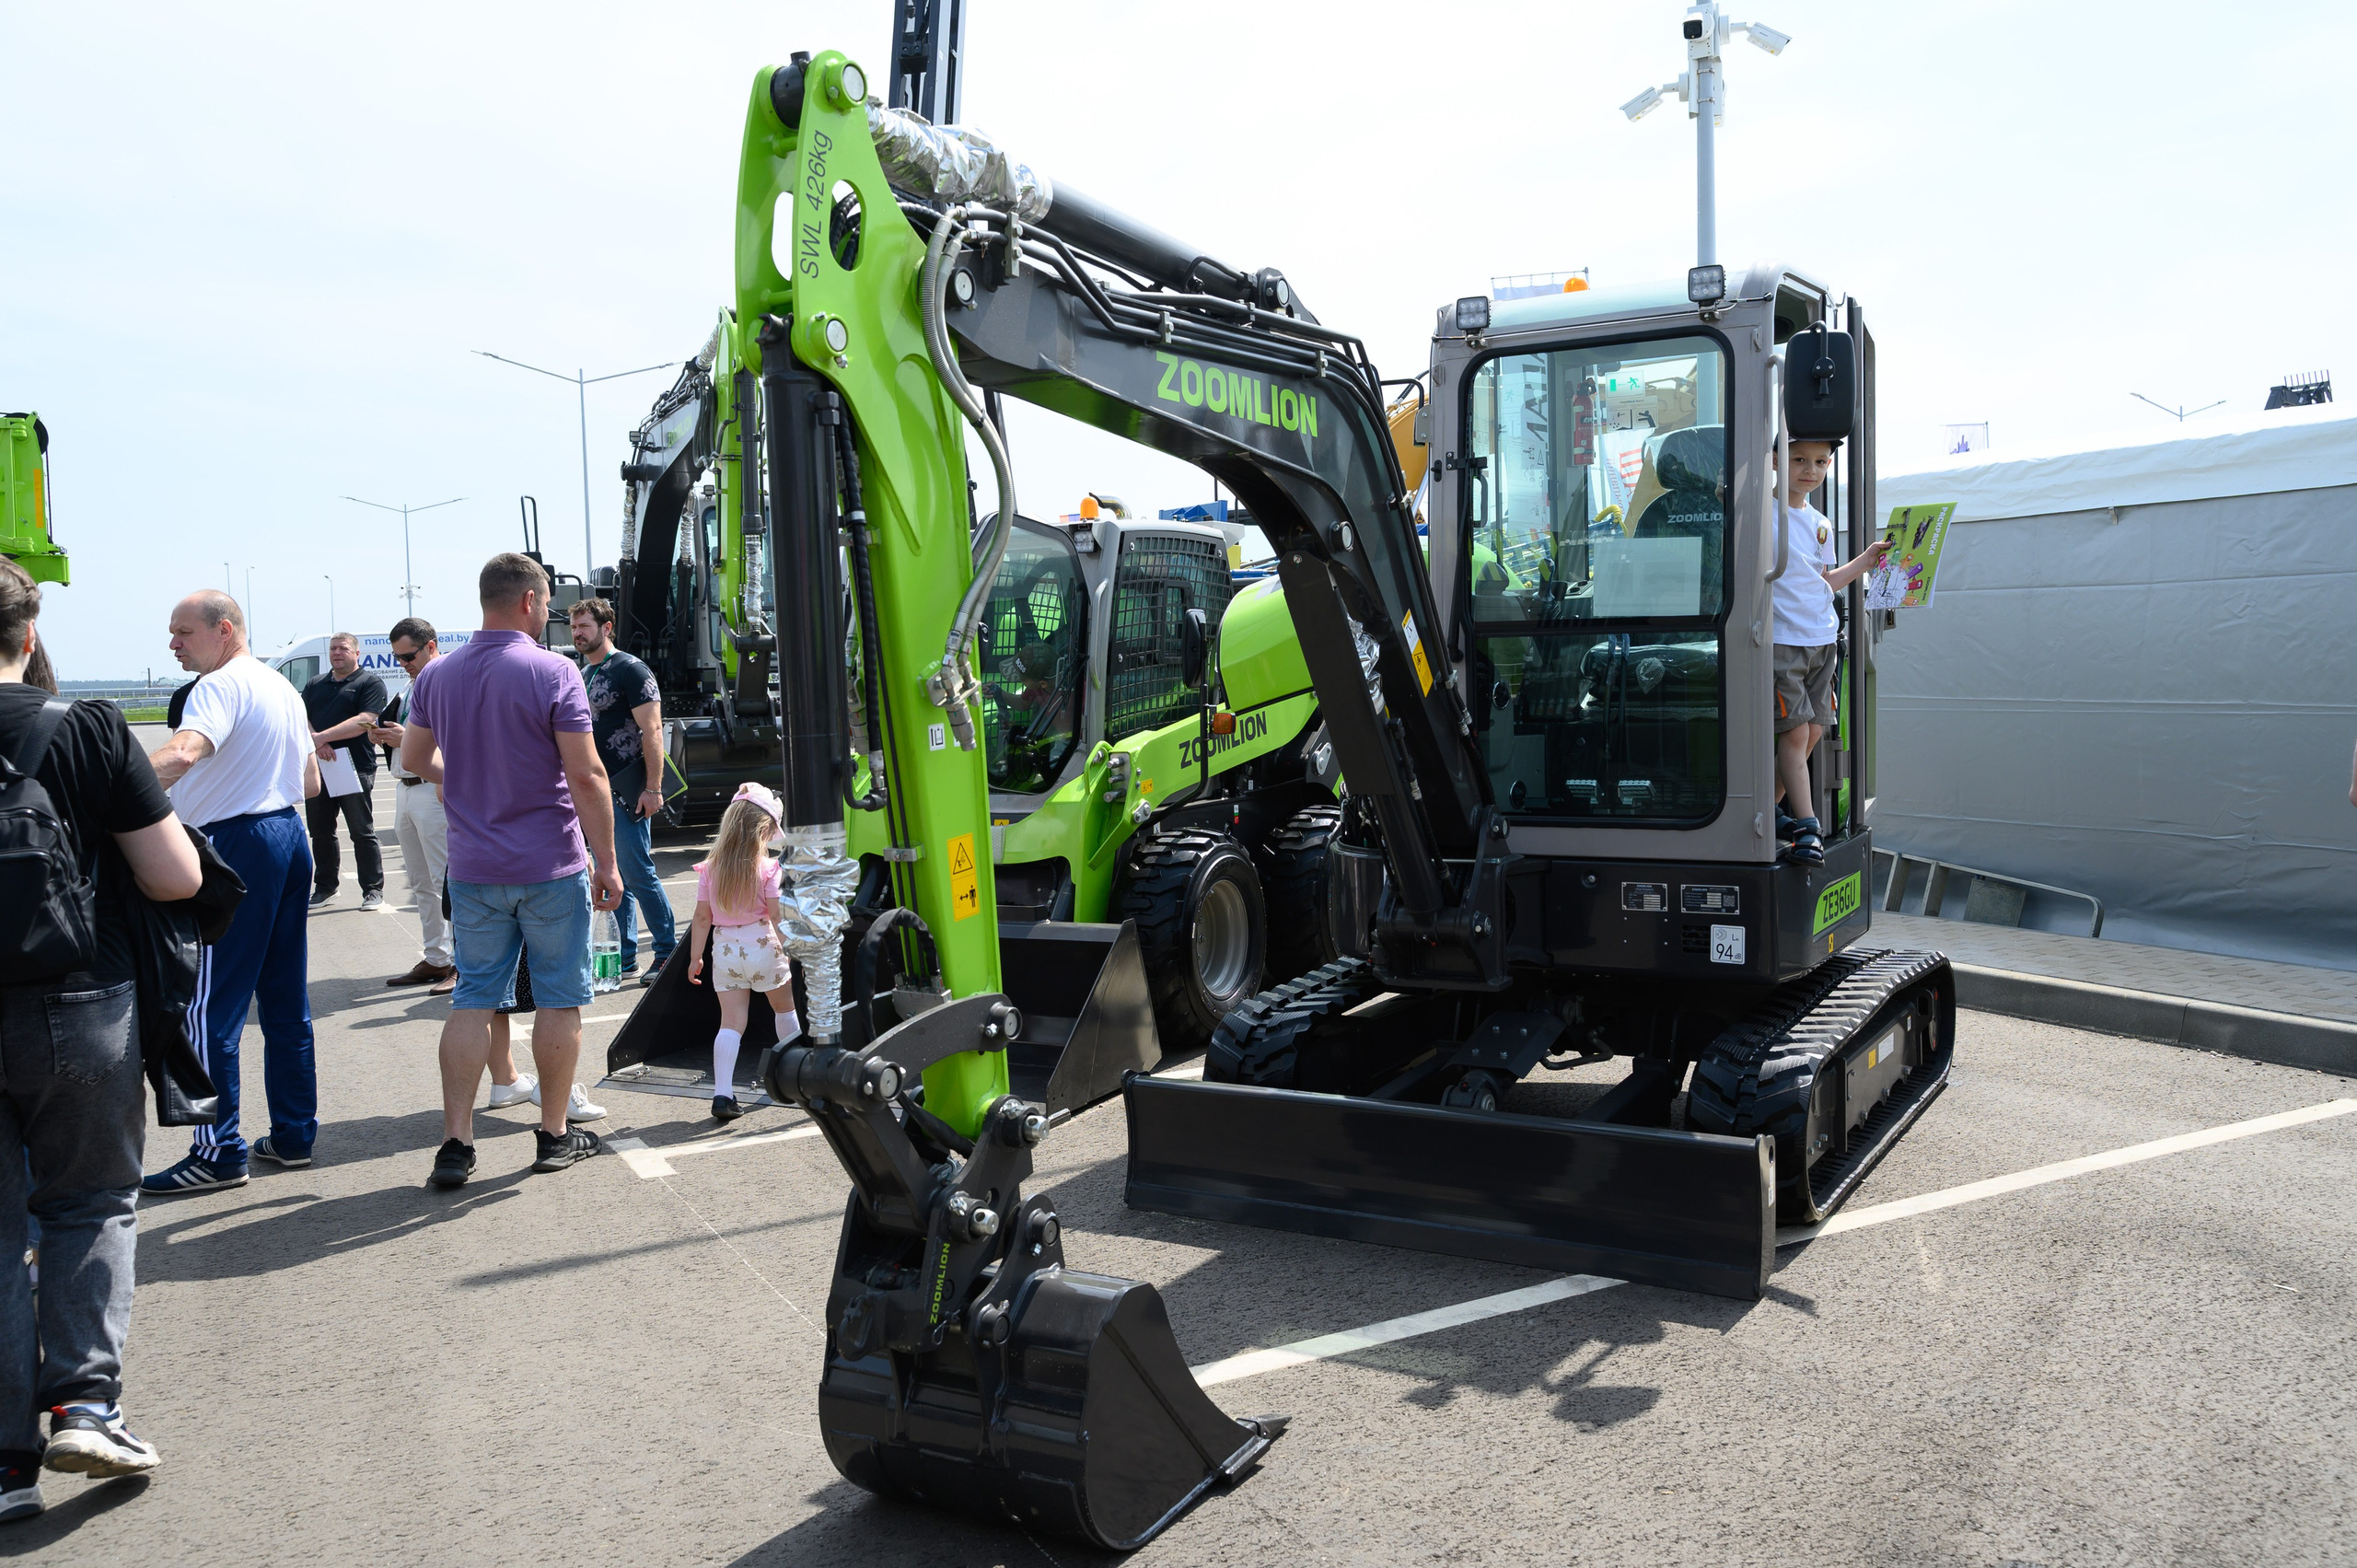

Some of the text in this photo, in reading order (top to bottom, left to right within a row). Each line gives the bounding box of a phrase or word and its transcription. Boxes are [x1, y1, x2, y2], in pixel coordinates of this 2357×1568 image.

[800, 130, 832, 279] SWL 426kg
[1156, 351, 1318, 437] ZOOMLION
[1667, 513, 1724, 524] ZOOMLIO
[1928, 506, 1948, 555] РАСКРАСКА
[1823, 879, 1855, 923] ZE36GU
[1716, 944, 1733, 960] 94
[930, 1243, 950, 1324] ZOOMLION
